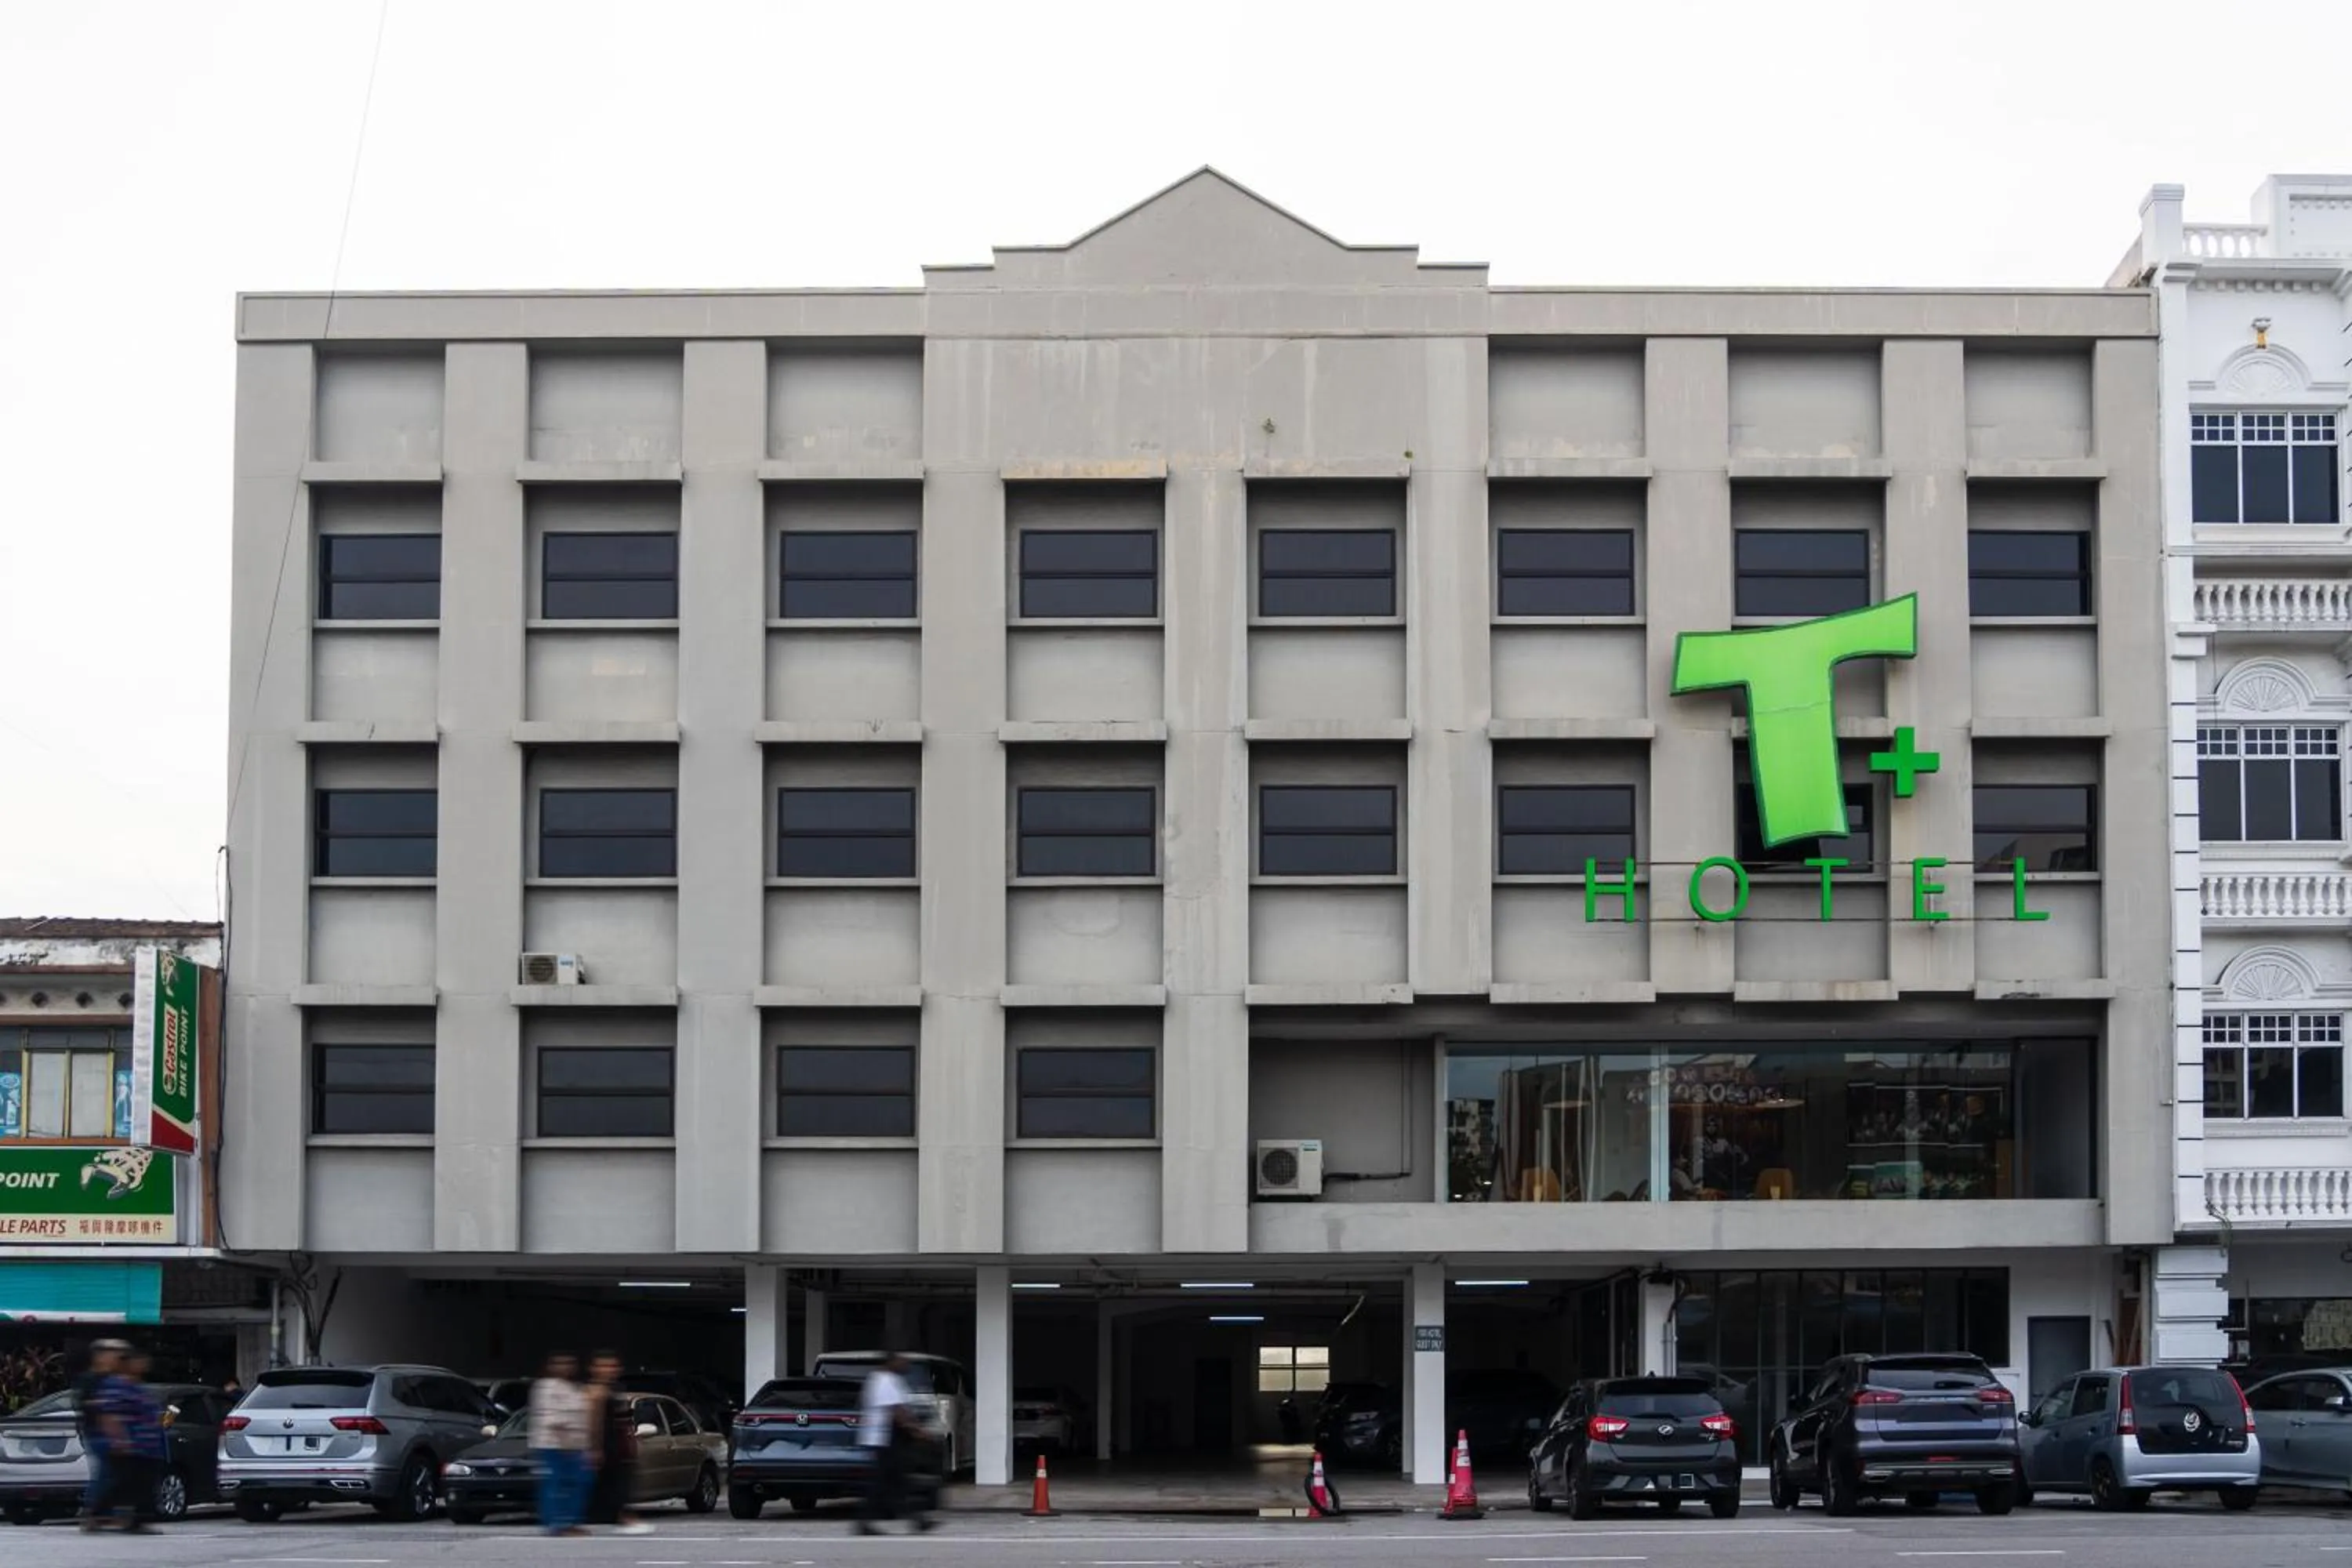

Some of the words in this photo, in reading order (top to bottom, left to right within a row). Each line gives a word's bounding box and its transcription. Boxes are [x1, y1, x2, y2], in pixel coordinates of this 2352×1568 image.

[1584, 856, 2049, 922] HOTEL
[165, 1011, 176, 1073] Castrol
[180, 1005, 190, 1056] POINT
[179, 1060, 188, 1098] BIKE
[20, 1219, 67, 1234] PARTS
